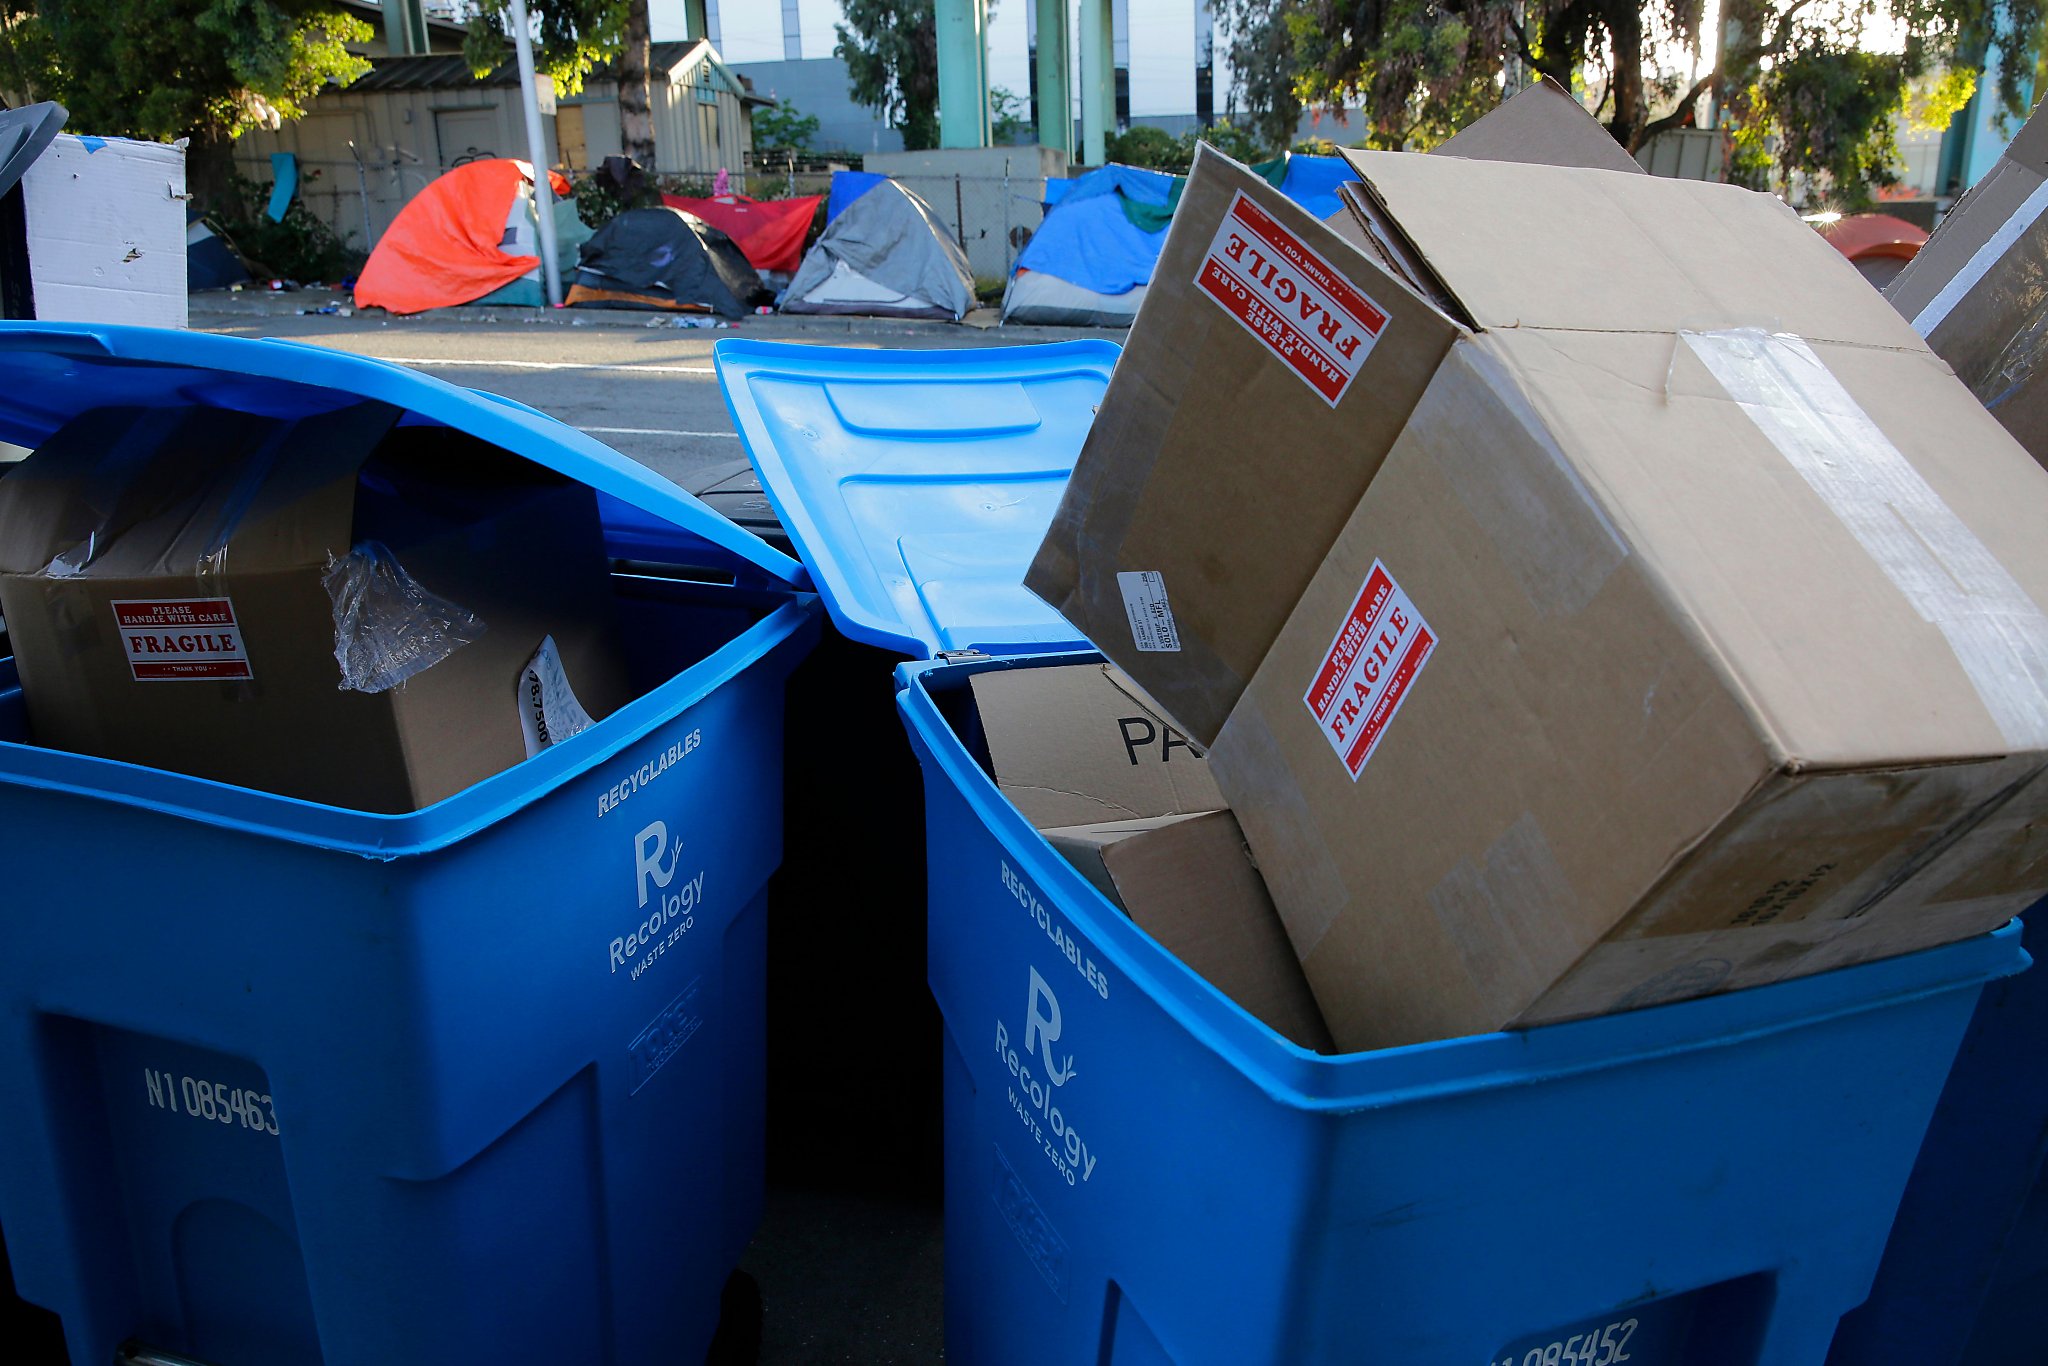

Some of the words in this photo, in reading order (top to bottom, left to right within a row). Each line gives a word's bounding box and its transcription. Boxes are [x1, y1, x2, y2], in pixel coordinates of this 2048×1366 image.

[1284, 246, 1301, 263] YOU
[1303, 261, 1331, 287] THANK
[1211, 266, 1247, 300] CARE
[1225, 233, 1361, 360] FRAGILE
[1246, 310, 1294, 357] PLEASE
[1249, 298, 1283, 331] WITH
[1285, 330, 1339, 382] HANDLE
[123, 615, 165, 624] HANDLE
[167, 614, 196, 622] WITH
[198, 613, 228, 621] CARE
[153, 606, 192, 614] PLEASE
[1154, 600, 1165, 618] MFL
[129, 634, 236, 653] FRAGILE
[1162, 626, 1173, 649] SOLO
[1317, 659, 1347, 712] HANDLE
[1346, 625, 1366, 663] WITH
[1365, 584, 1388, 622] CARE
[1331, 616, 1361, 667] PLEASE
[1330, 606, 1409, 743] FRAGILE
[1372, 696, 1391, 724] THANK
[1388, 680, 1400, 698] YOU
[529, 670, 548, 743] 78.7500
[598, 728, 701, 818] RECYCLABLES
[634, 820, 678, 909] R
[609, 871, 704, 974] Recology
[630, 941, 665, 981] WASTE
[668, 915, 694, 948] ZERO
[1001, 859, 1109, 1000] RECYCLABLES
[1025, 964, 1070, 1088] R
[182, 1076, 280, 1136] 085463
[996, 1019, 1097, 1182] Recology
[1008, 1086, 1041, 1144] WASTE
[1045, 1139, 1075, 1186] ZERO
